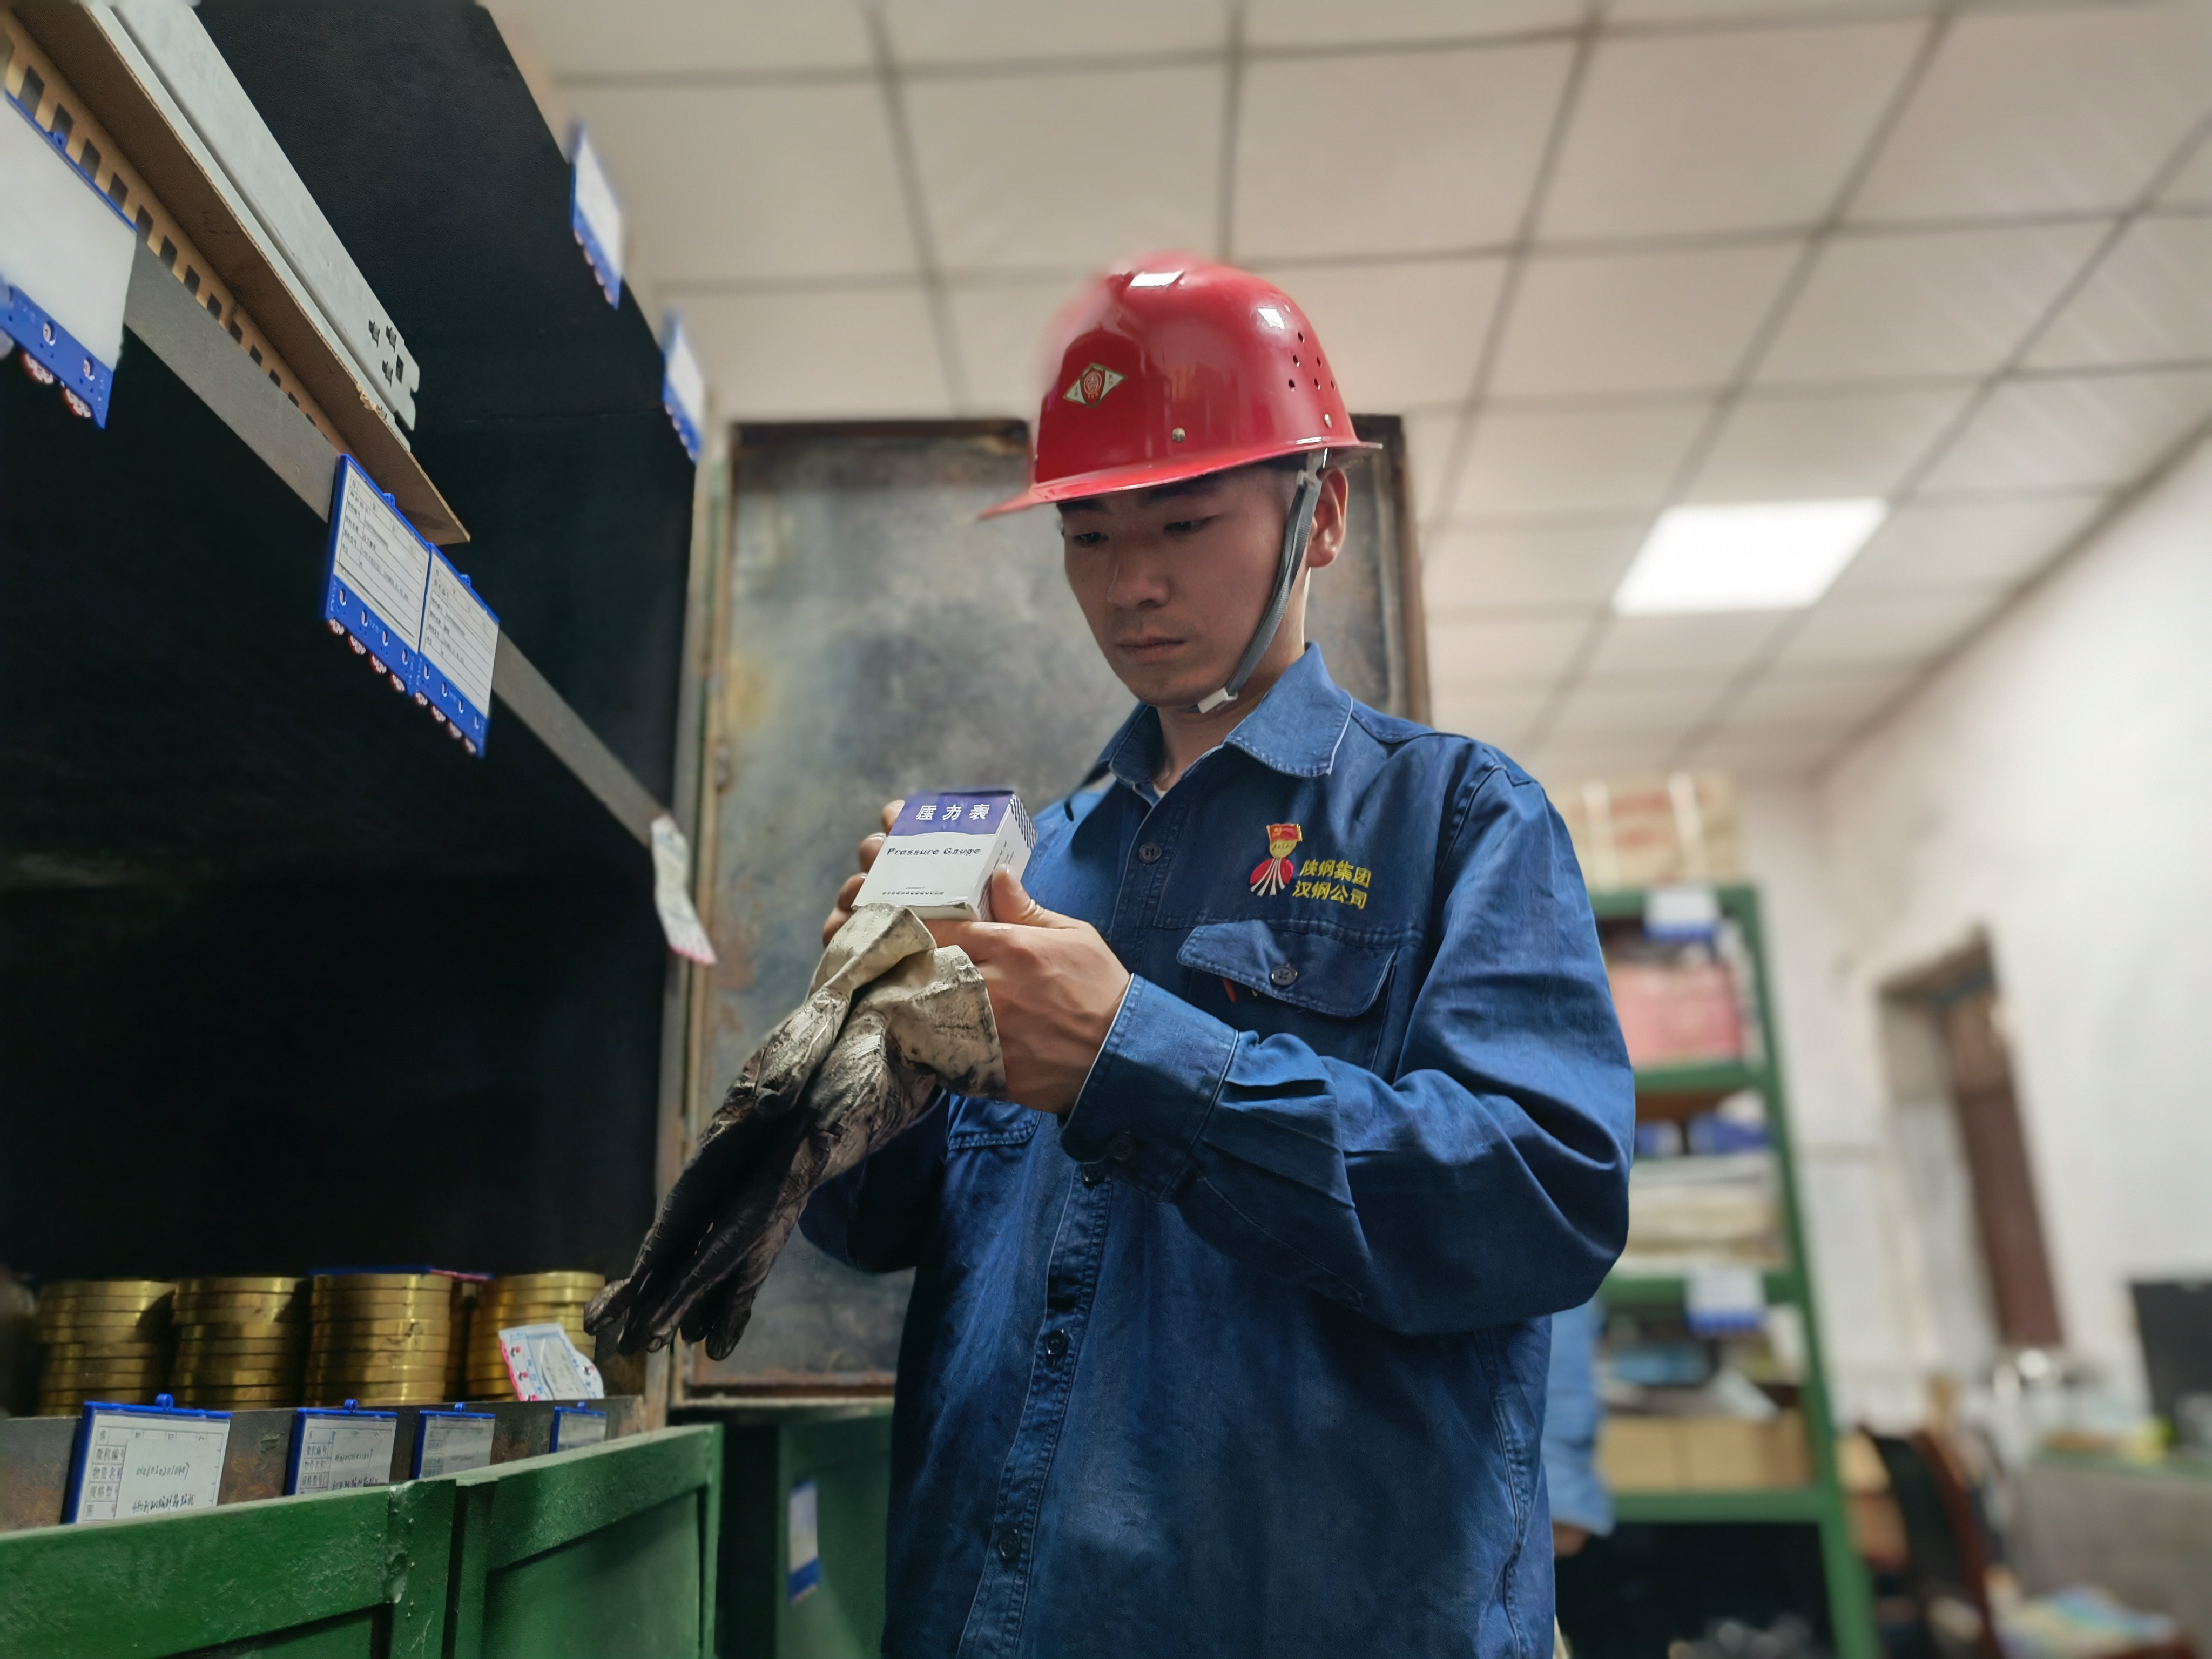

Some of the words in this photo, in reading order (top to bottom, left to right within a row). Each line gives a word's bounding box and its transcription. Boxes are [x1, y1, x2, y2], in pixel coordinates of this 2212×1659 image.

[886, 847, 939, 856] Pressure
[943, 847, 982, 857] Gauge
[1299, 859, 1372, 887] 陕钢集团
[1293, 881, 1367, 909] 汉钢公司
